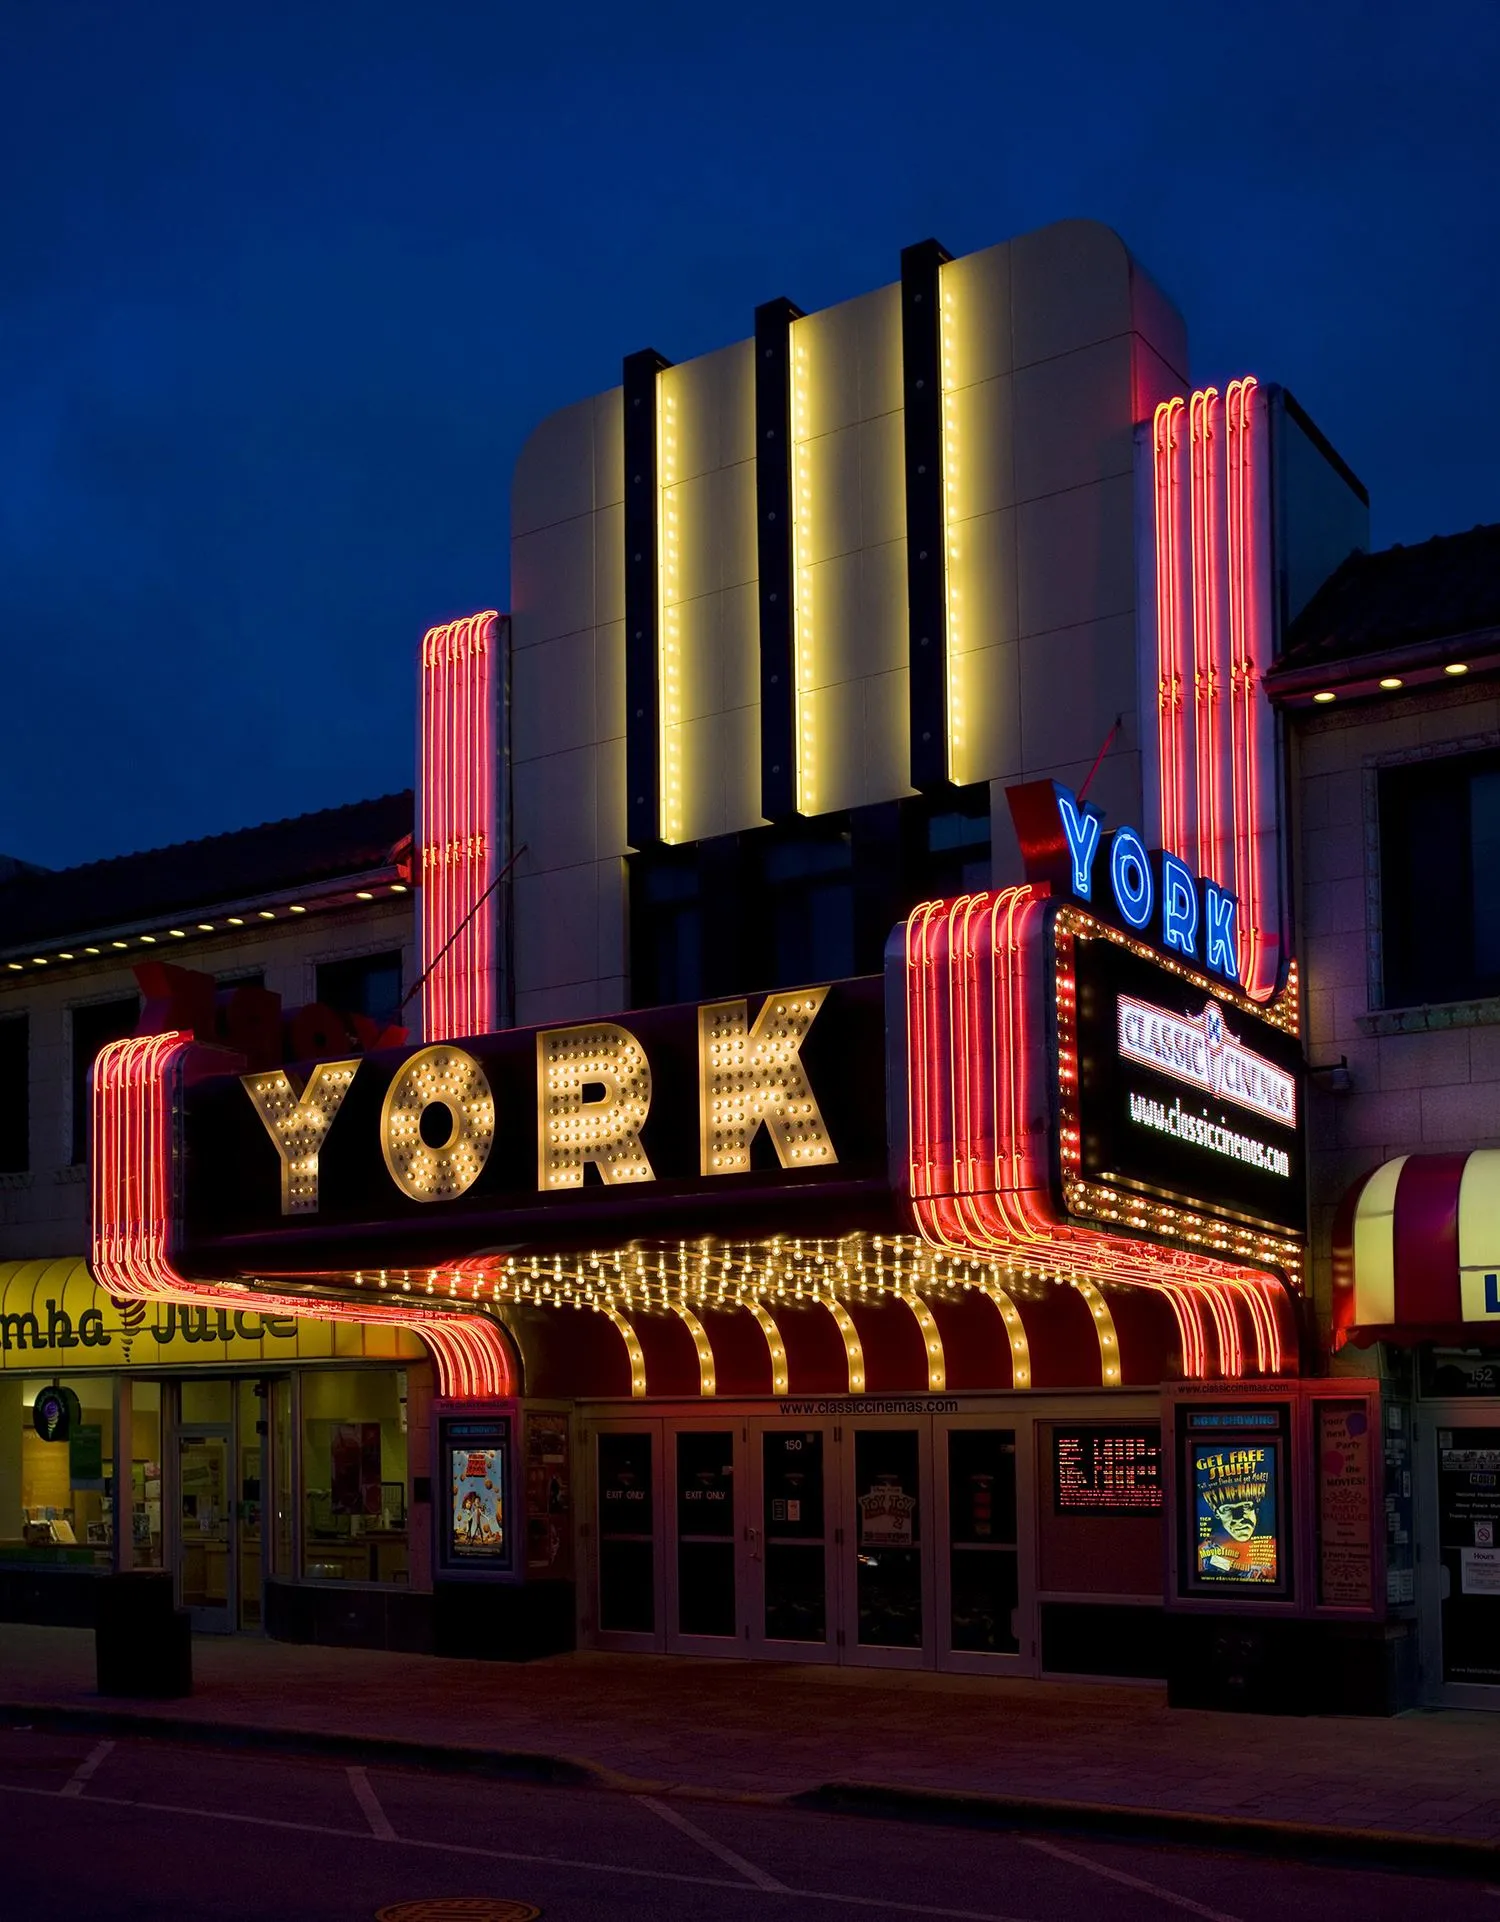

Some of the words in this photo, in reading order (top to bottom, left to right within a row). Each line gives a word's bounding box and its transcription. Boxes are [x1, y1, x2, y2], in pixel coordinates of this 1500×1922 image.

[1053, 782, 1240, 981] YORK
[1124, 1012, 1207, 1076] CLASSIC
[239, 986, 839, 1216] YORK
[1130, 1092, 1289, 1178] www.classiccinemas.com
[0, 1299, 112, 1349] mba
[1471, 1368, 1493, 1382] 152
[1178, 1383, 1289, 1394] www.classiccinemas.com
[779, 1401, 958, 1414] www.classiccinemas.com
[784, 1439, 802, 1451] 150
[1196, 1453, 1223, 1470] GET
[1229, 1449, 1265, 1464] FREE
[1209, 1461, 1257, 1480] STUFF!
[605, 1490, 623, 1500] EXIT
[625, 1490, 645, 1500] ONLY
[685, 1490, 702, 1500] EXIT
[705, 1490, 726, 1500] ONLY
